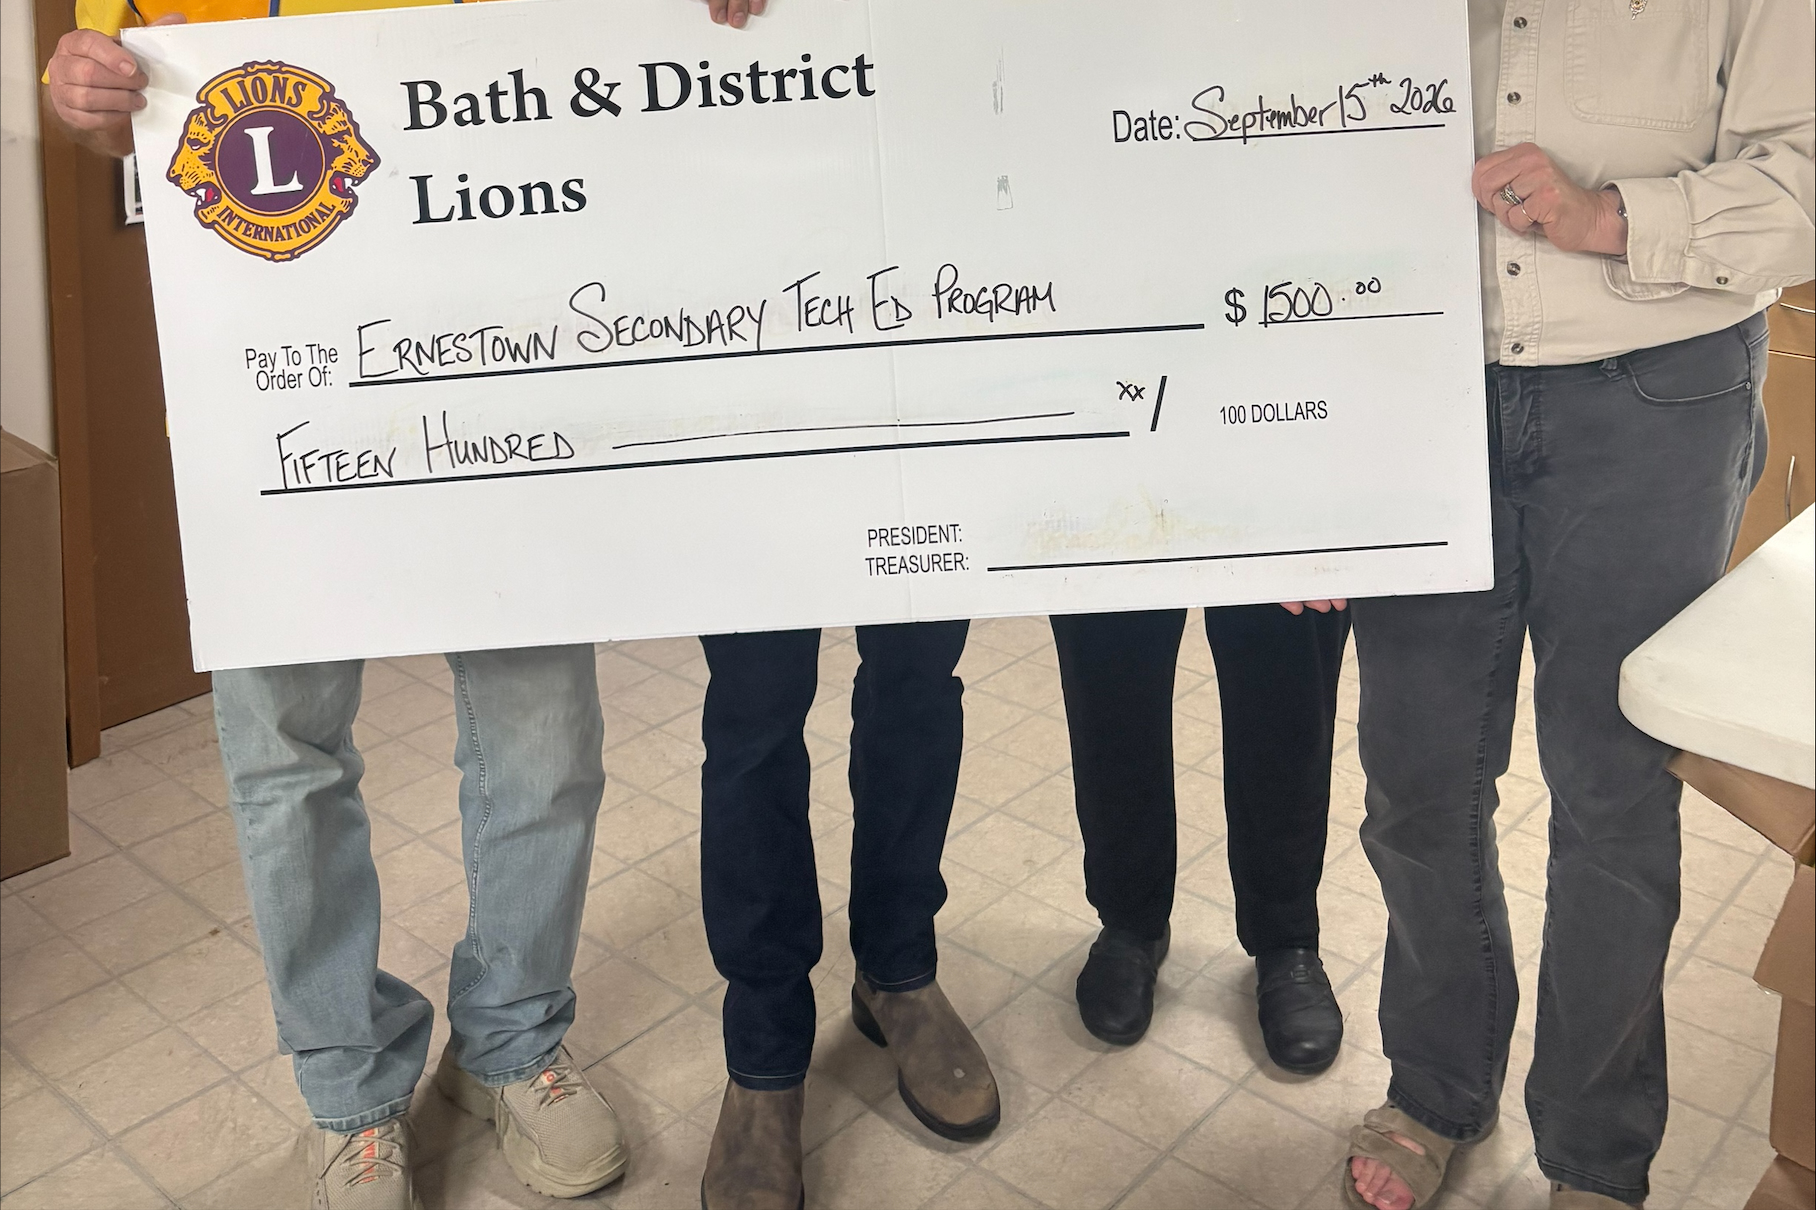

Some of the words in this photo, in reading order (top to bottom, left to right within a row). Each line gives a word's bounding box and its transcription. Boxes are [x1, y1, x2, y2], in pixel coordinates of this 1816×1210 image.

[219, 75, 307, 117] LIONS
[399, 67, 553, 131] Bath
[569, 66, 622, 118] &
[638, 52, 876, 113] District
[1183, 85, 1337, 144] September
[1389, 77, 1457, 116] 2026
[1112, 109, 1181, 143] Date:
[243, 126, 304, 196] L
[408, 172, 588, 225] Lions
[216, 201, 337, 243] INTERNATIONAL
[356, 319, 560, 379] ERNESTOWN
[568, 281, 768, 352] SECONDARY
[782, 270, 855, 334] TECH
[932, 263, 1057, 320] PROGRAM
[1223, 286, 1248, 327] $
[245, 347, 278, 370] Pay
[280, 345, 302, 368] To
[305, 343, 339, 365] The
[256, 367, 304, 392] Order
[308, 365, 334, 388] Of:
[1219, 404, 1247, 426] 100
[1251, 400, 1329, 424] DOLLARS
[275, 420, 398, 490] FIFTEEN
[421, 409, 575, 474] HUNDRED
[866, 523, 963, 549] PRESIDENT:
[865, 552, 971, 578] TREASURER:
